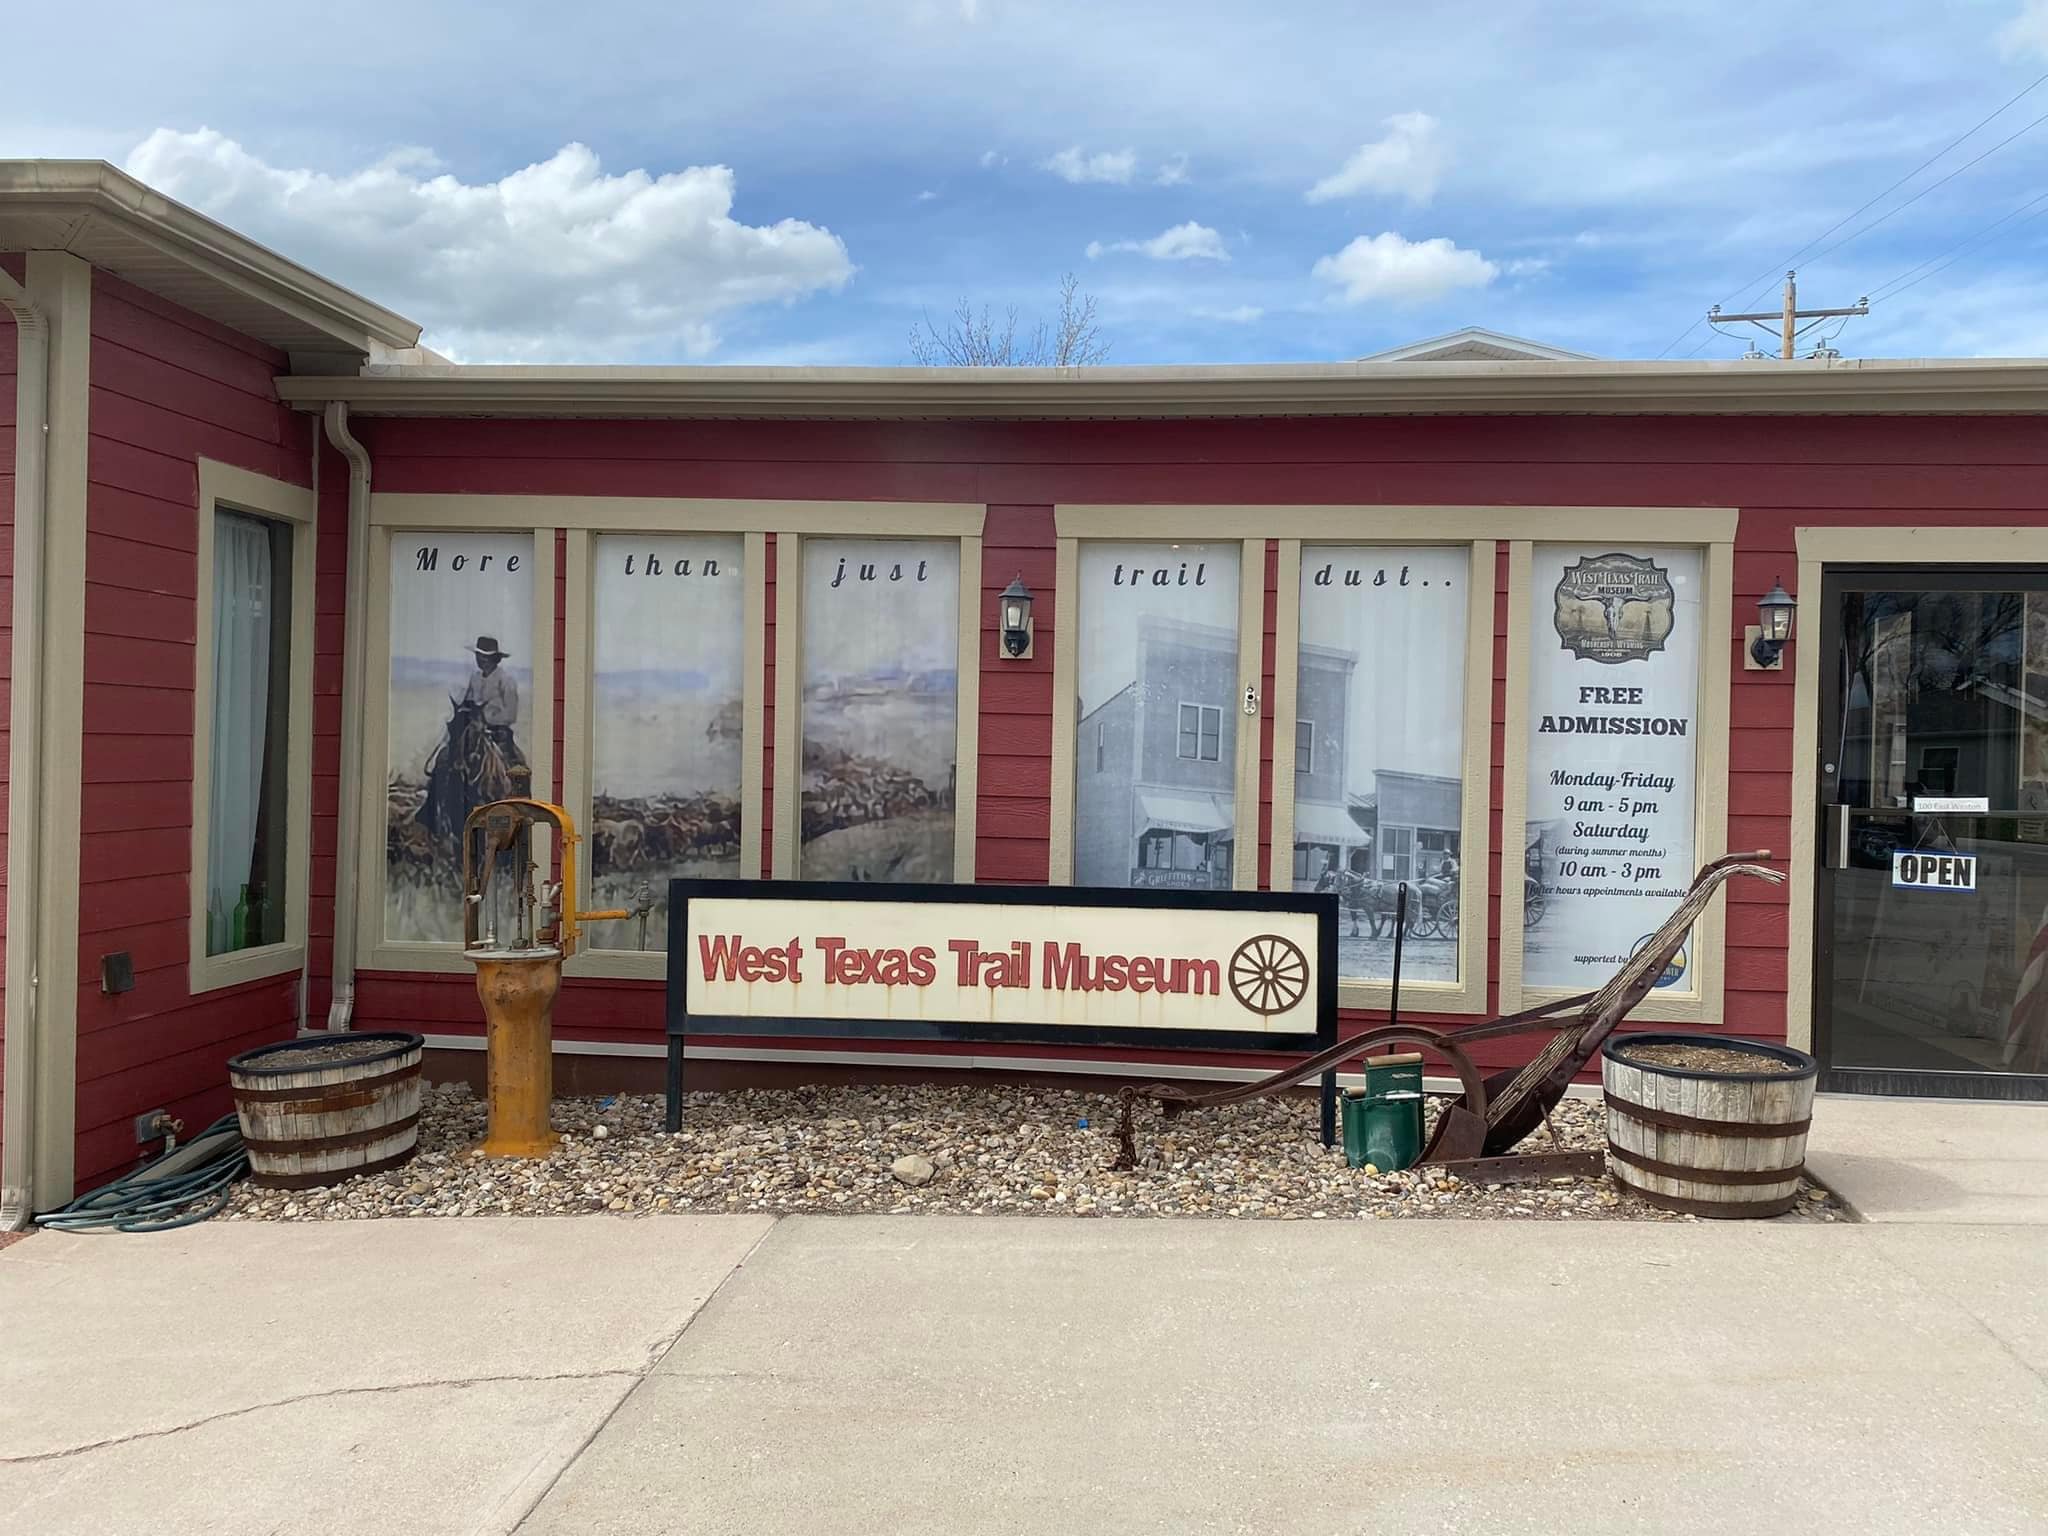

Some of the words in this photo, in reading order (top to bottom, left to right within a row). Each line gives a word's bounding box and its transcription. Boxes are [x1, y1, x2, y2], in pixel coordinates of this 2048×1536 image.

[416, 548, 521, 572] More
[625, 554, 721, 577] than
[831, 558, 929, 588] just
[1114, 562, 1206, 586] trail
[1571, 572, 1598, 584] WEST
[1599, 572, 1630, 585] TEXAS
[1630, 572, 1659, 585] TRAIL
[1598, 586, 1633, 595] MUSEUM
[1579, 686, 1643, 704] FREE
[1538, 715, 1688, 736] ADMISSION
[1550, 769, 1675, 792] Monday-Friday
[1564, 795, 1574, 811] 9
[1578, 800, 1604, 812] am
[1618, 797, 1629, 813] 5
[1632, 801, 1658, 817] pm
[1573, 821, 1649, 843] Saturday
[1555, 846, 1589, 857] (during
[1591, 848, 1627, 856] summer
[1629, 848, 1667, 858] months)
[1559, 861, 1577, 877] 10
[1580, 865, 1607, 877] am
[1621, 863, 1632, 878] 3
[1634, 867, 1661, 882] pm
[1900, 855, 1971, 886] OPEN
[1556, 886, 1581, 895] hours
[1583, 887, 1643, 898] appointments
[699, 935, 802, 982] West
[816, 937, 936, 986] Texas
[949, 939, 1030, 989] Trail
[1043, 942, 1220, 996] Museum
[1574, 955, 1616, 965] supported
